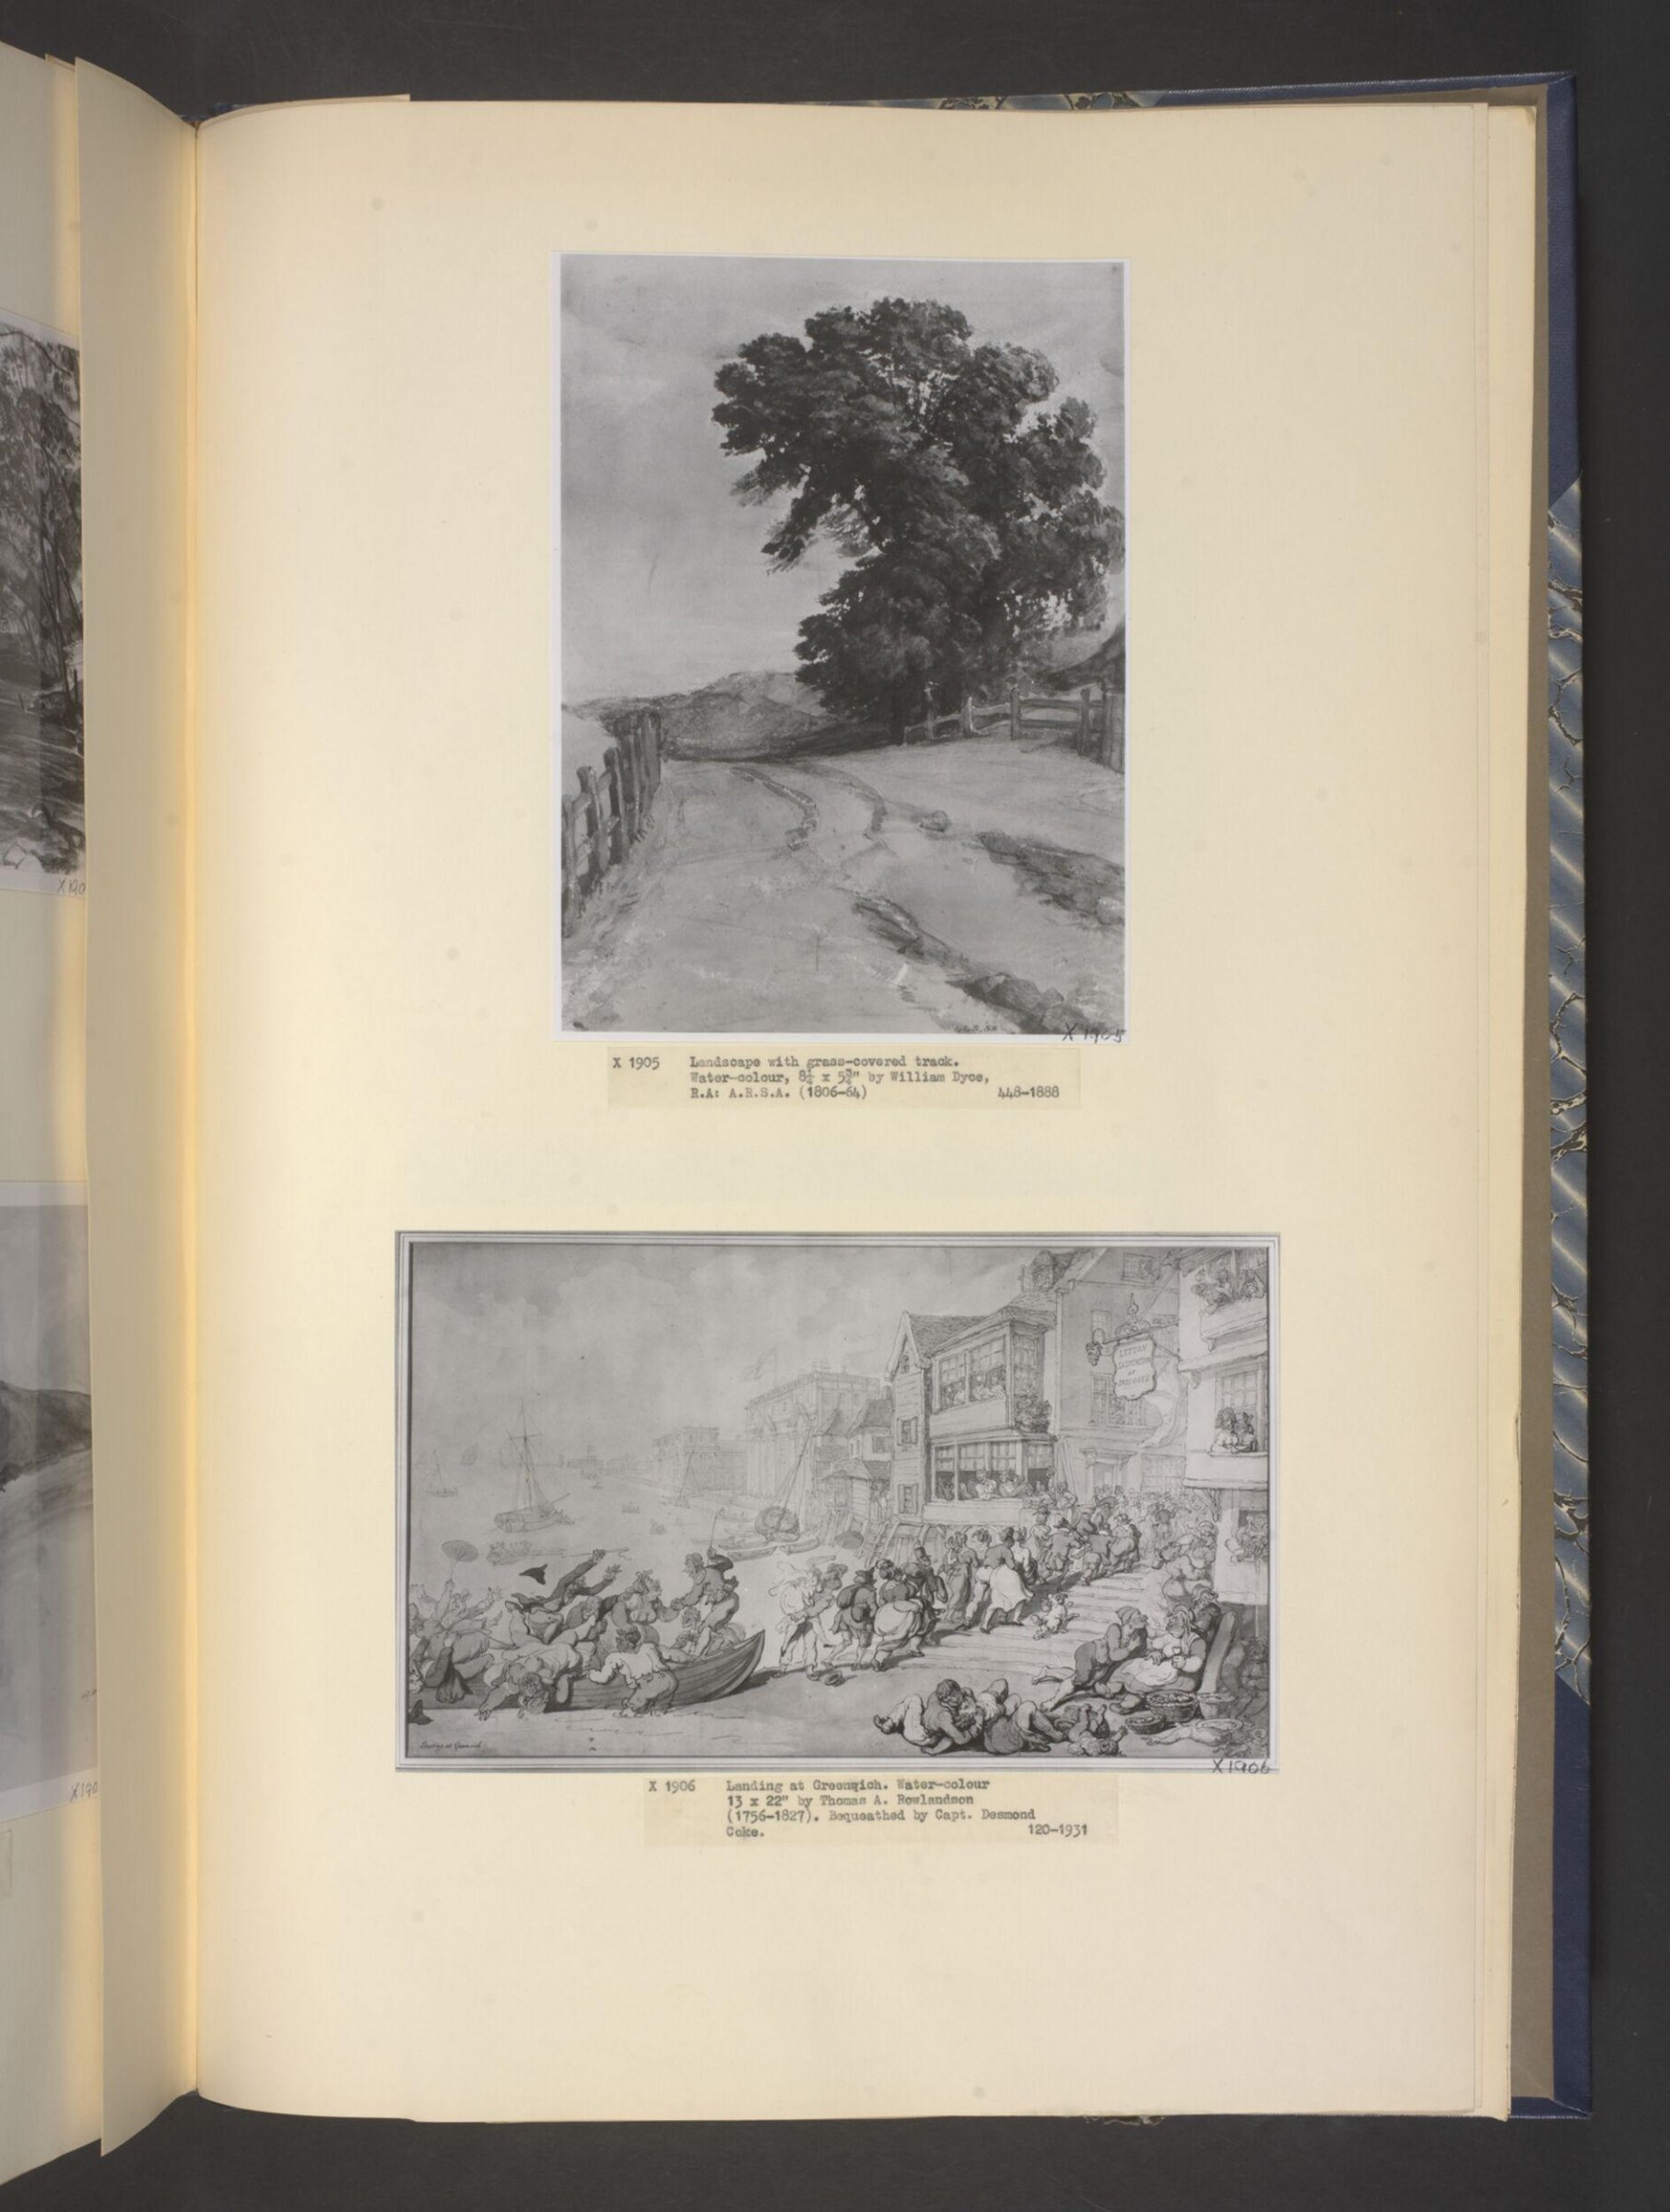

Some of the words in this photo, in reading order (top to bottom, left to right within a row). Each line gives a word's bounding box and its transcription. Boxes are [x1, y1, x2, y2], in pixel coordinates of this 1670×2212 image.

[1062, 1022, 1078, 1041] X
[612, 1056, 622, 1068] X
[629, 1055, 661, 1070] 1905
[688, 1055, 761, 1069] Landscape
[767, 1055, 800, 1067] with
[806, 1055, 908, 1070] grass-covered
[914, 1055, 960, 1067] track.
[689, 1071, 790, 1085] Water-colour,
[821, 1073, 831, 1082] x
[867, 1071, 885, 1084] by
[889, 1070, 946, 1083] William
[951, 1070, 990, 1086] Dyce,
[728, 1087, 791, 1100] A.R.S.A.
[799, 1084, 867, 1100] (1806-64)
[997, 1086, 1061, 1100] 448-1888
[1212, 1758, 1224, 1773] X
[1229, 1759, 1270, 1774] 1906
[648, 1780, 658, 1792] X
[664, 1779, 697, 1794] 1906
[725, 1780, 784, 1794] Landing
[789, 1780, 806, 1792] at
[896, 1778, 991, 1791] Water-colour
[726, 1794, 743, 1808] 13
[749, 1797, 759, 1807] x
[766, 1794, 789, 1807] 22"
[797, 1794, 814, 1809] by
[819, 1794, 867, 1806] Thomas
[873, 1794, 888, 1806] A.
[896, 1794, 975, 1806] Rowlandson
[726, 1807, 820, 1824] (1756-1827).
[828, 1809, 906, 1824] Bequeathed
[912, 1809, 929, 1823] by
[935, 1808, 972, 1823] Capt.
[981, 1808, 1037, 1821] Desmond
[725, 1825, 765, 1839] Coke.
[1028, 1823, 1088, 1839] 120-1931
